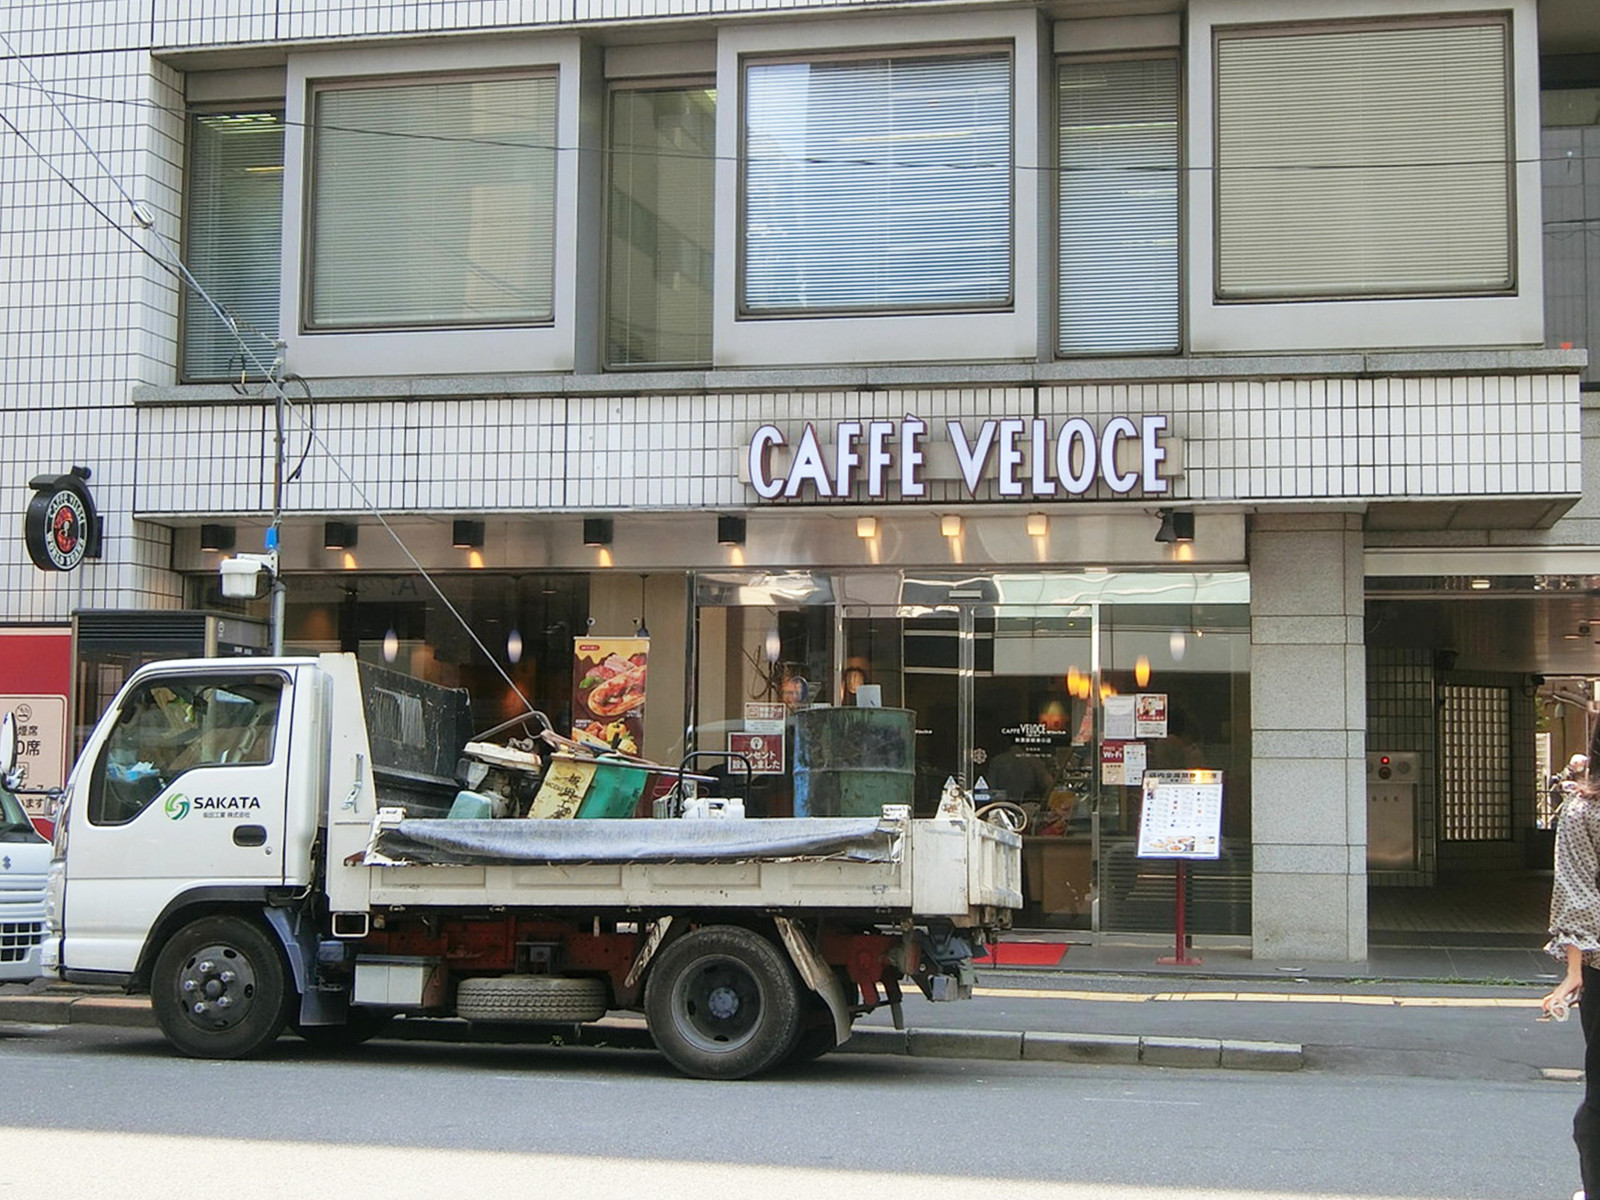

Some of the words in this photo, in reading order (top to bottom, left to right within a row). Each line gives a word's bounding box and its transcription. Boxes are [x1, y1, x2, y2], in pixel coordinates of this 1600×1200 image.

[748, 412, 928, 499] CAFFÈ
[946, 414, 1169, 498] VELOCE
[193, 796, 260, 809] SAKATA
